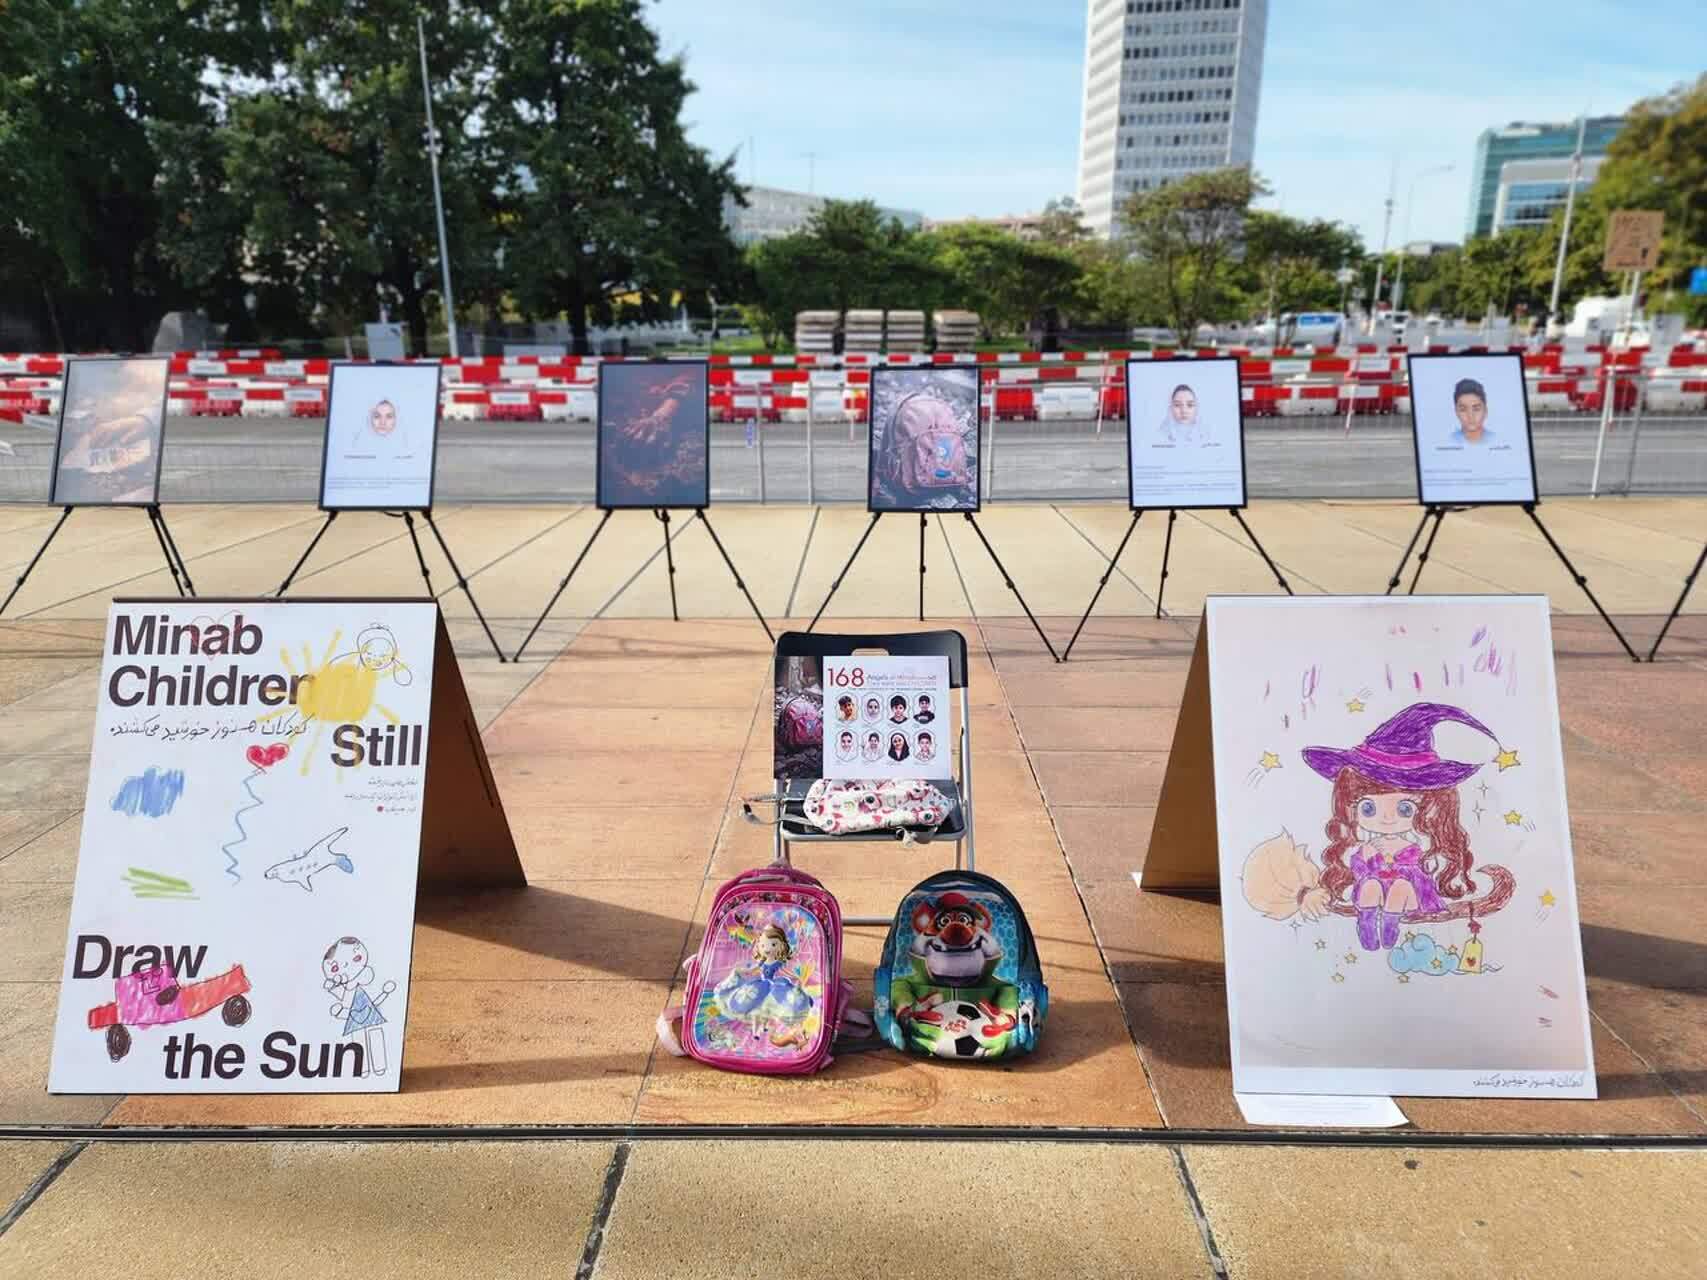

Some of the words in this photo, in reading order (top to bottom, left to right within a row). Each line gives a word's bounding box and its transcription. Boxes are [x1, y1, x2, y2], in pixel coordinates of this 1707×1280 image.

[112, 615, 263, 656] Minab
[827, 667, 865, 687] 168
[330, 724, 422, 767] Still
[72, 935, 208, 980] Draw
[163, 1033, 245, 1079] the
[260, 1030, 365, 1080] Sun
